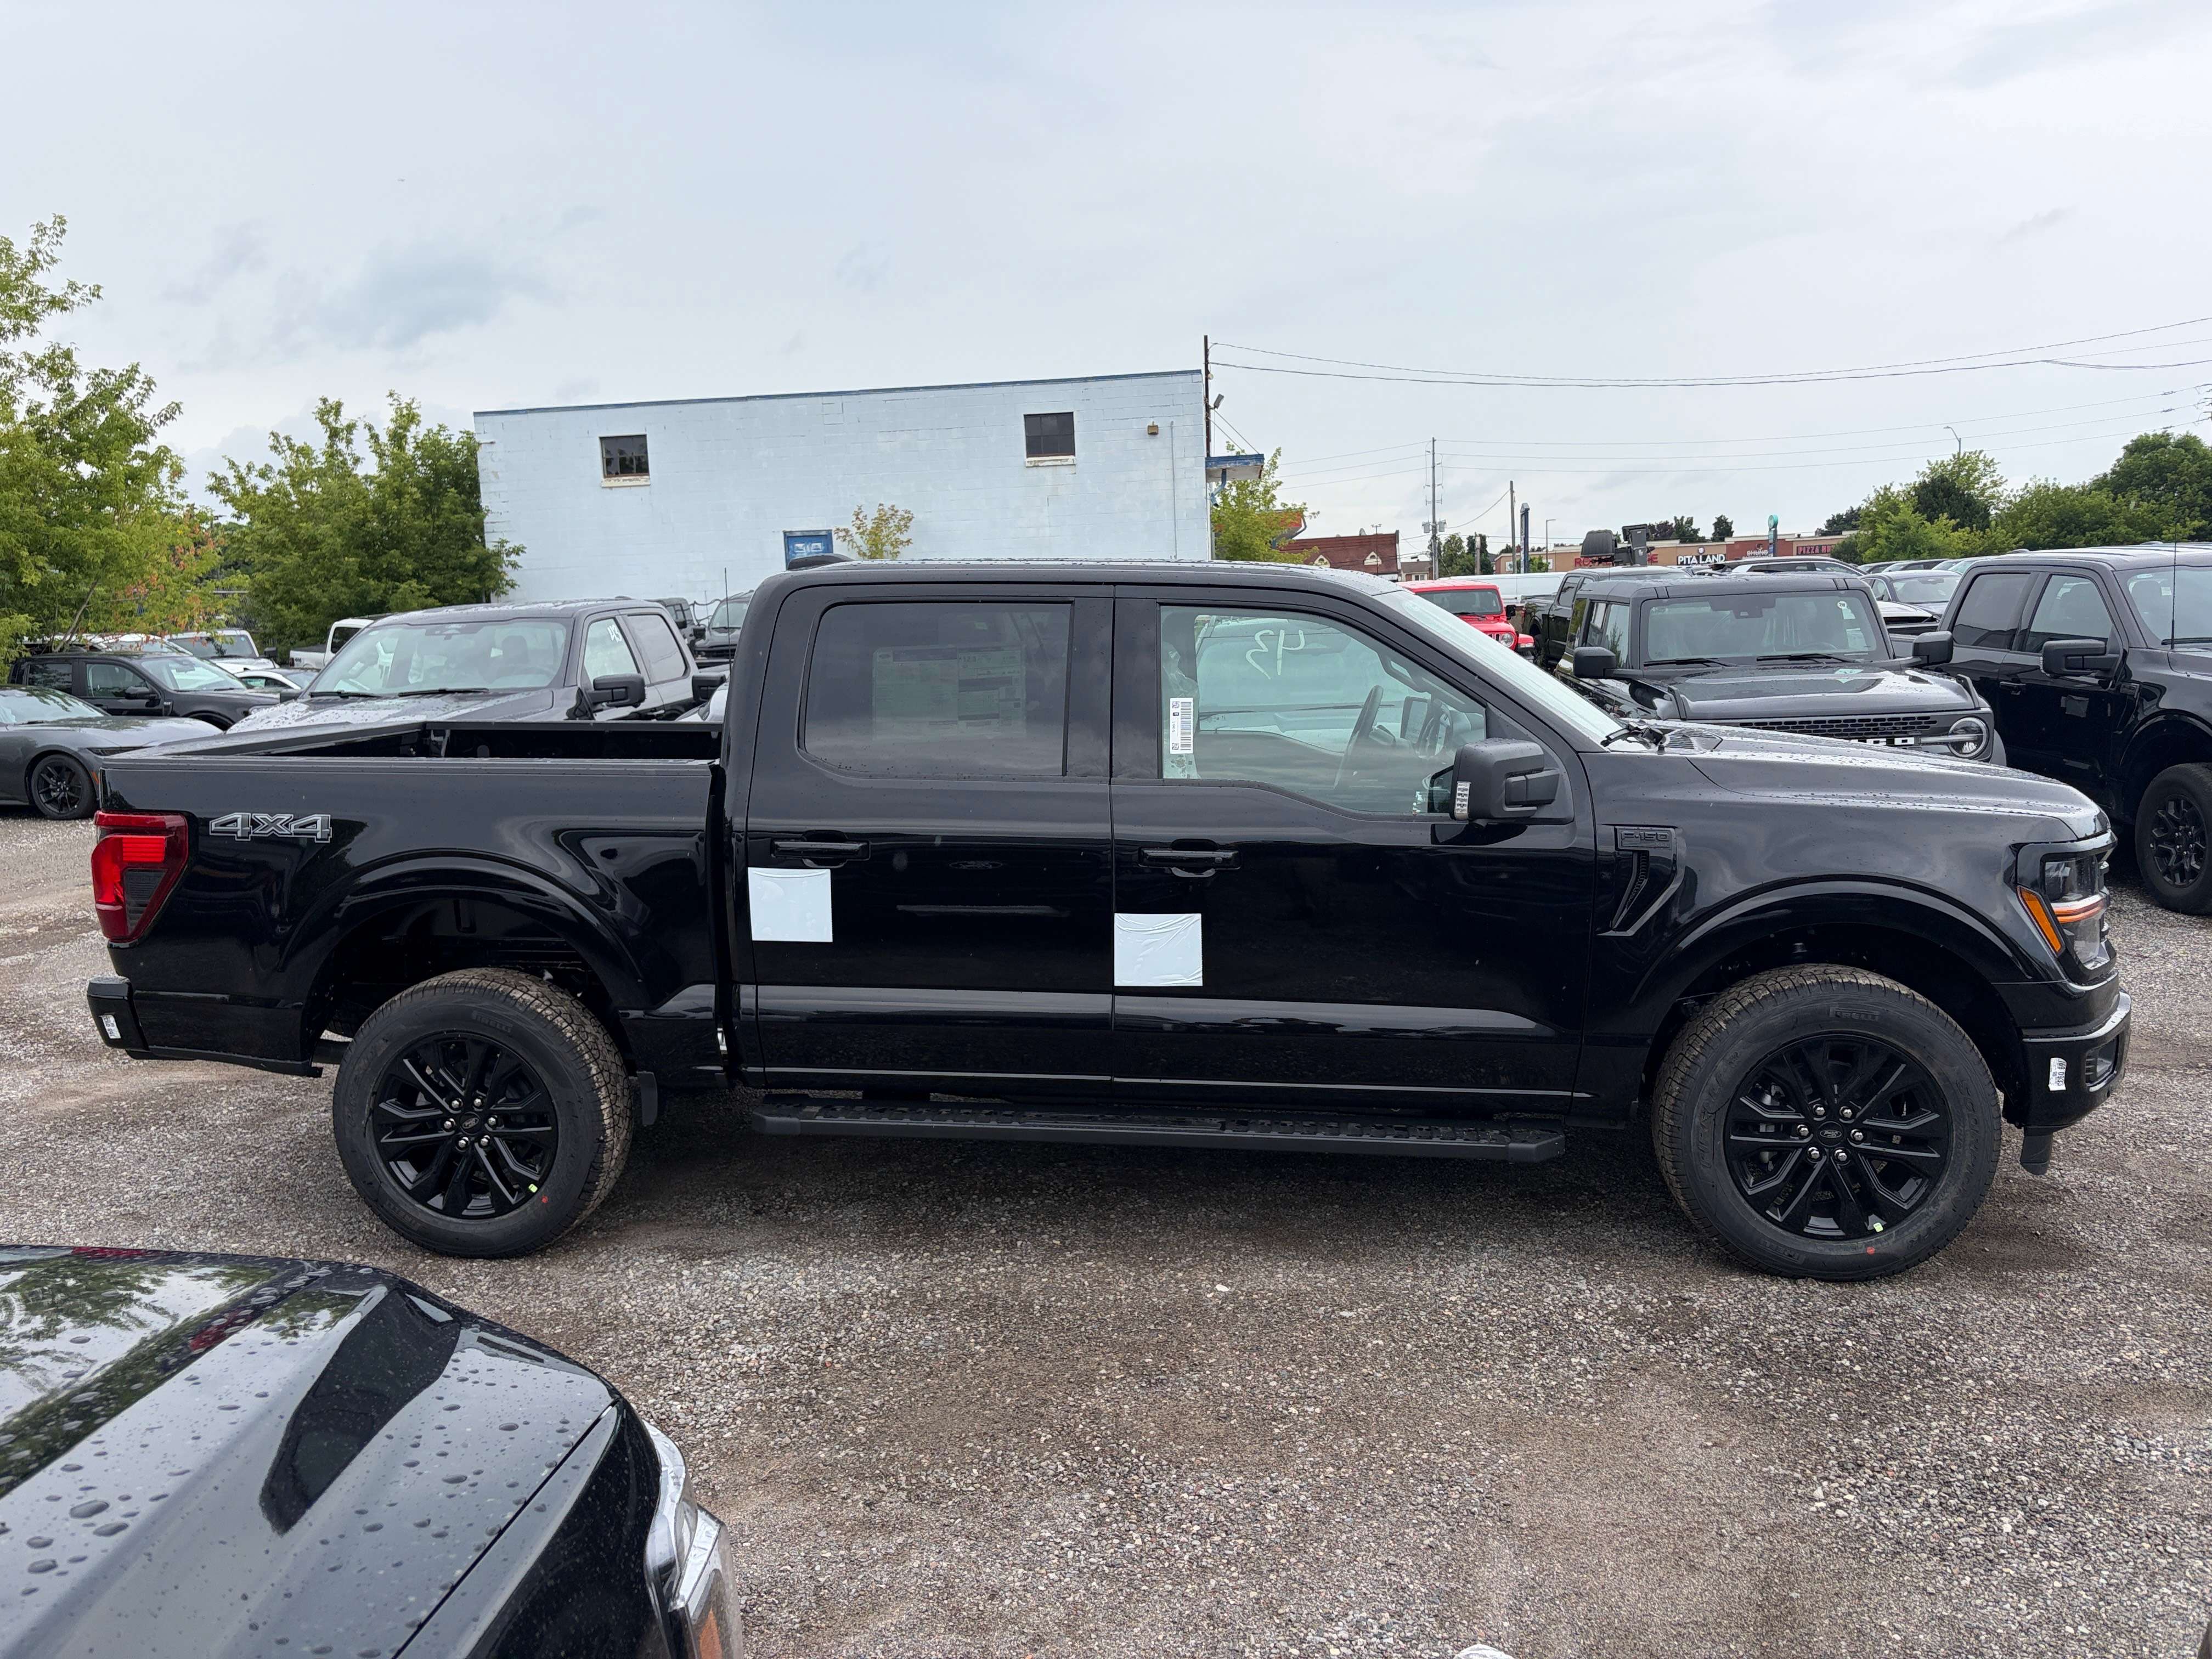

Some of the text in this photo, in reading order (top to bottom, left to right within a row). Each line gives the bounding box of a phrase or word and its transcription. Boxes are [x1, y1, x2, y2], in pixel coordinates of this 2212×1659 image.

[1798, 545, 1819, 554] PIZZA
[1678, 554, 1725, 565] PITA LAND
